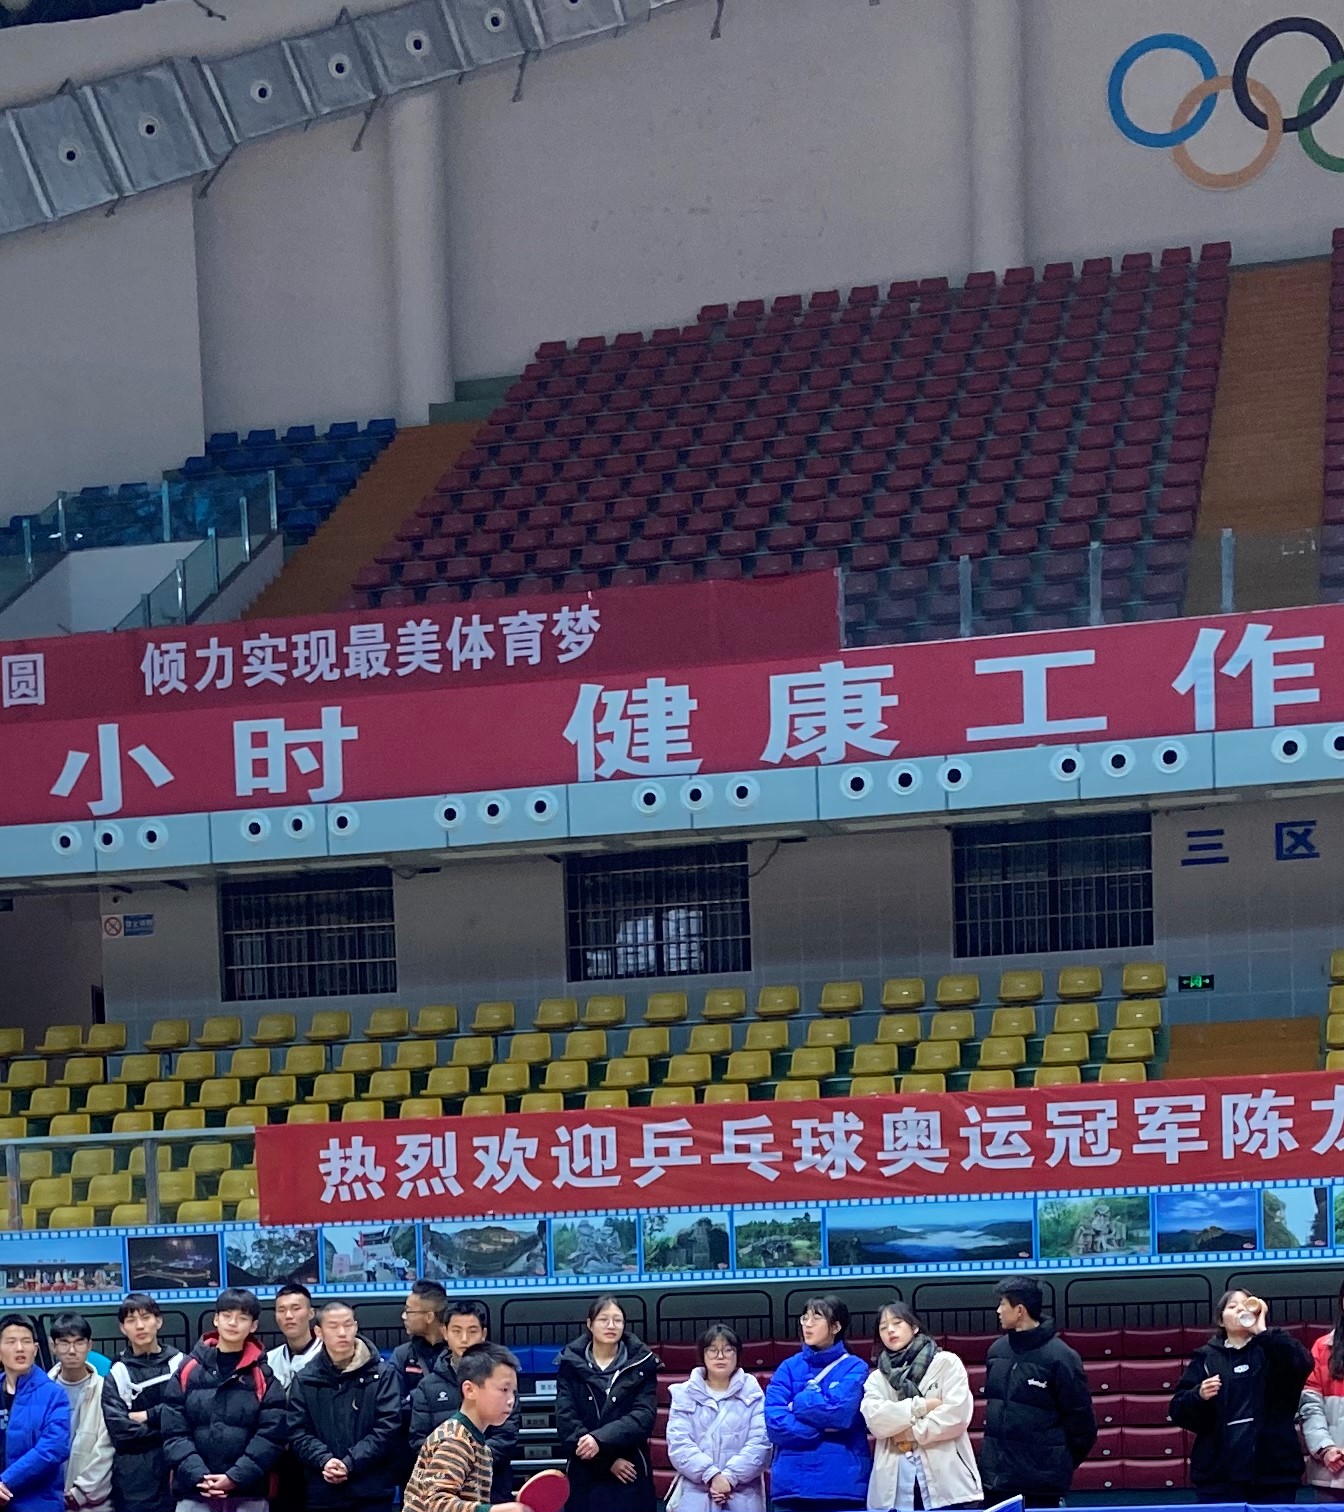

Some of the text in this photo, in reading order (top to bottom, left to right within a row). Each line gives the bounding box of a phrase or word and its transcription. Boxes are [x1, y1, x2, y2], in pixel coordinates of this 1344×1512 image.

[139, 604, 602, 696] 倾力实现最美体育梦
[1181, 819, 1321, 867] 三区
